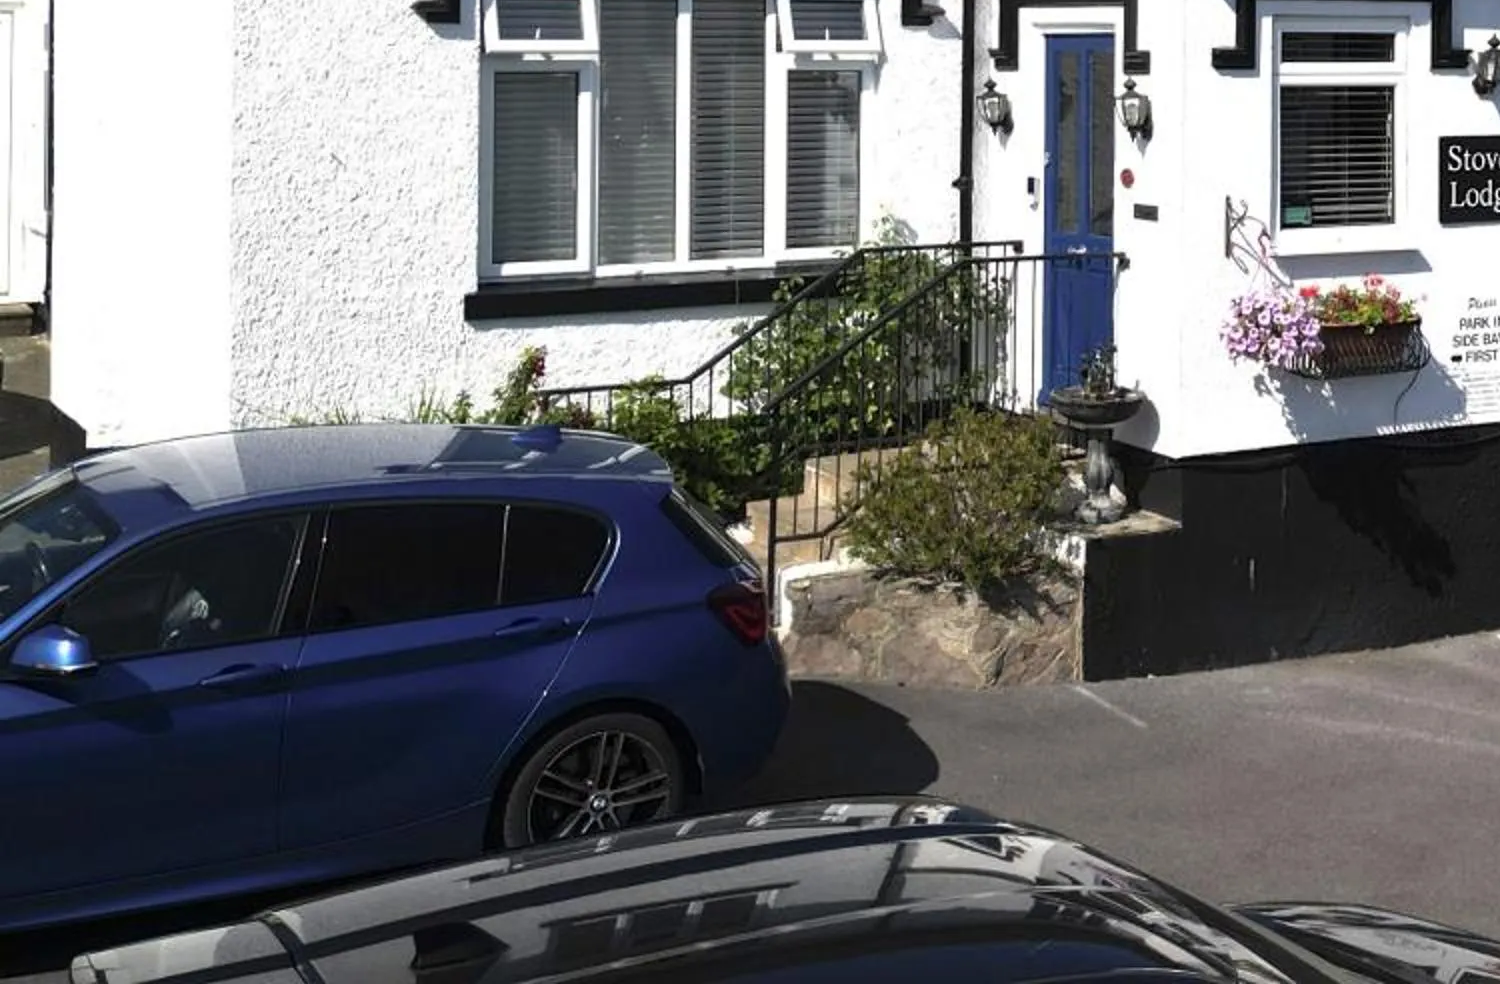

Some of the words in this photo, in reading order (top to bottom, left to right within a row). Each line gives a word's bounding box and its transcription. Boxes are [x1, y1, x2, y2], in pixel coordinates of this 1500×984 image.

[1459, 317, 1490, 331] PARK
[1452, 333, 1480, 348] SIDE
[1465, 349, 1498, 363] FIRST
